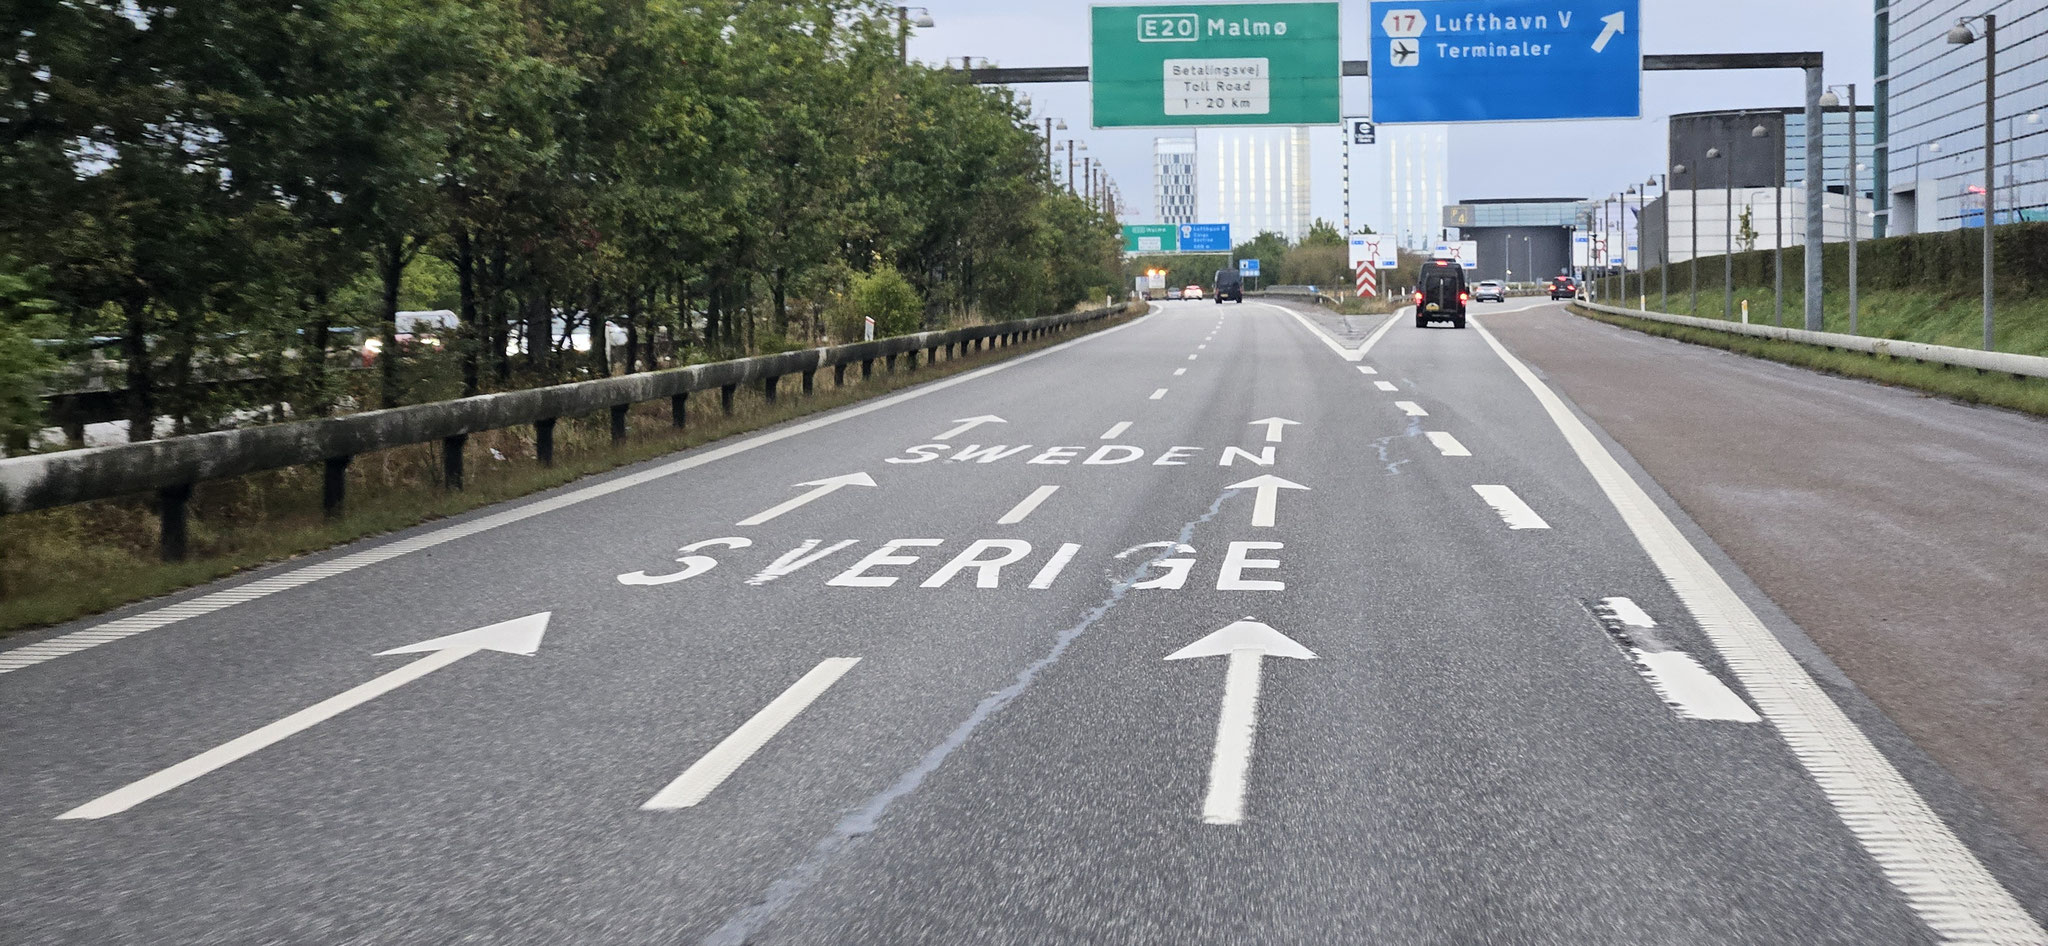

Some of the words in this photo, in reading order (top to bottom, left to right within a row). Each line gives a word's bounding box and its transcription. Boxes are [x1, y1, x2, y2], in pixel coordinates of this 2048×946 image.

[1145, 18, 1193, 37] E20
[1207, 17, 1288, 37] Malmø
[1392, 14, 1416, 32] 17
[1435, 12, 1548, 32] Lufthavn
[1557, 10, 1572, 29] V
[1436, 41, 1552, 58] Terminaler
[1172, 64, 1260, 77] Betalingsvej
[1183, 81, 1211, 92] Toll
[1216, 80, 1251, 92] Road
[1183, 97, 1189, 109] 1
[1206, 97, 1225, 109] 20
[1231, 97, 1251, 109] km
[884, 444, 1275, 466] SWEDEN
